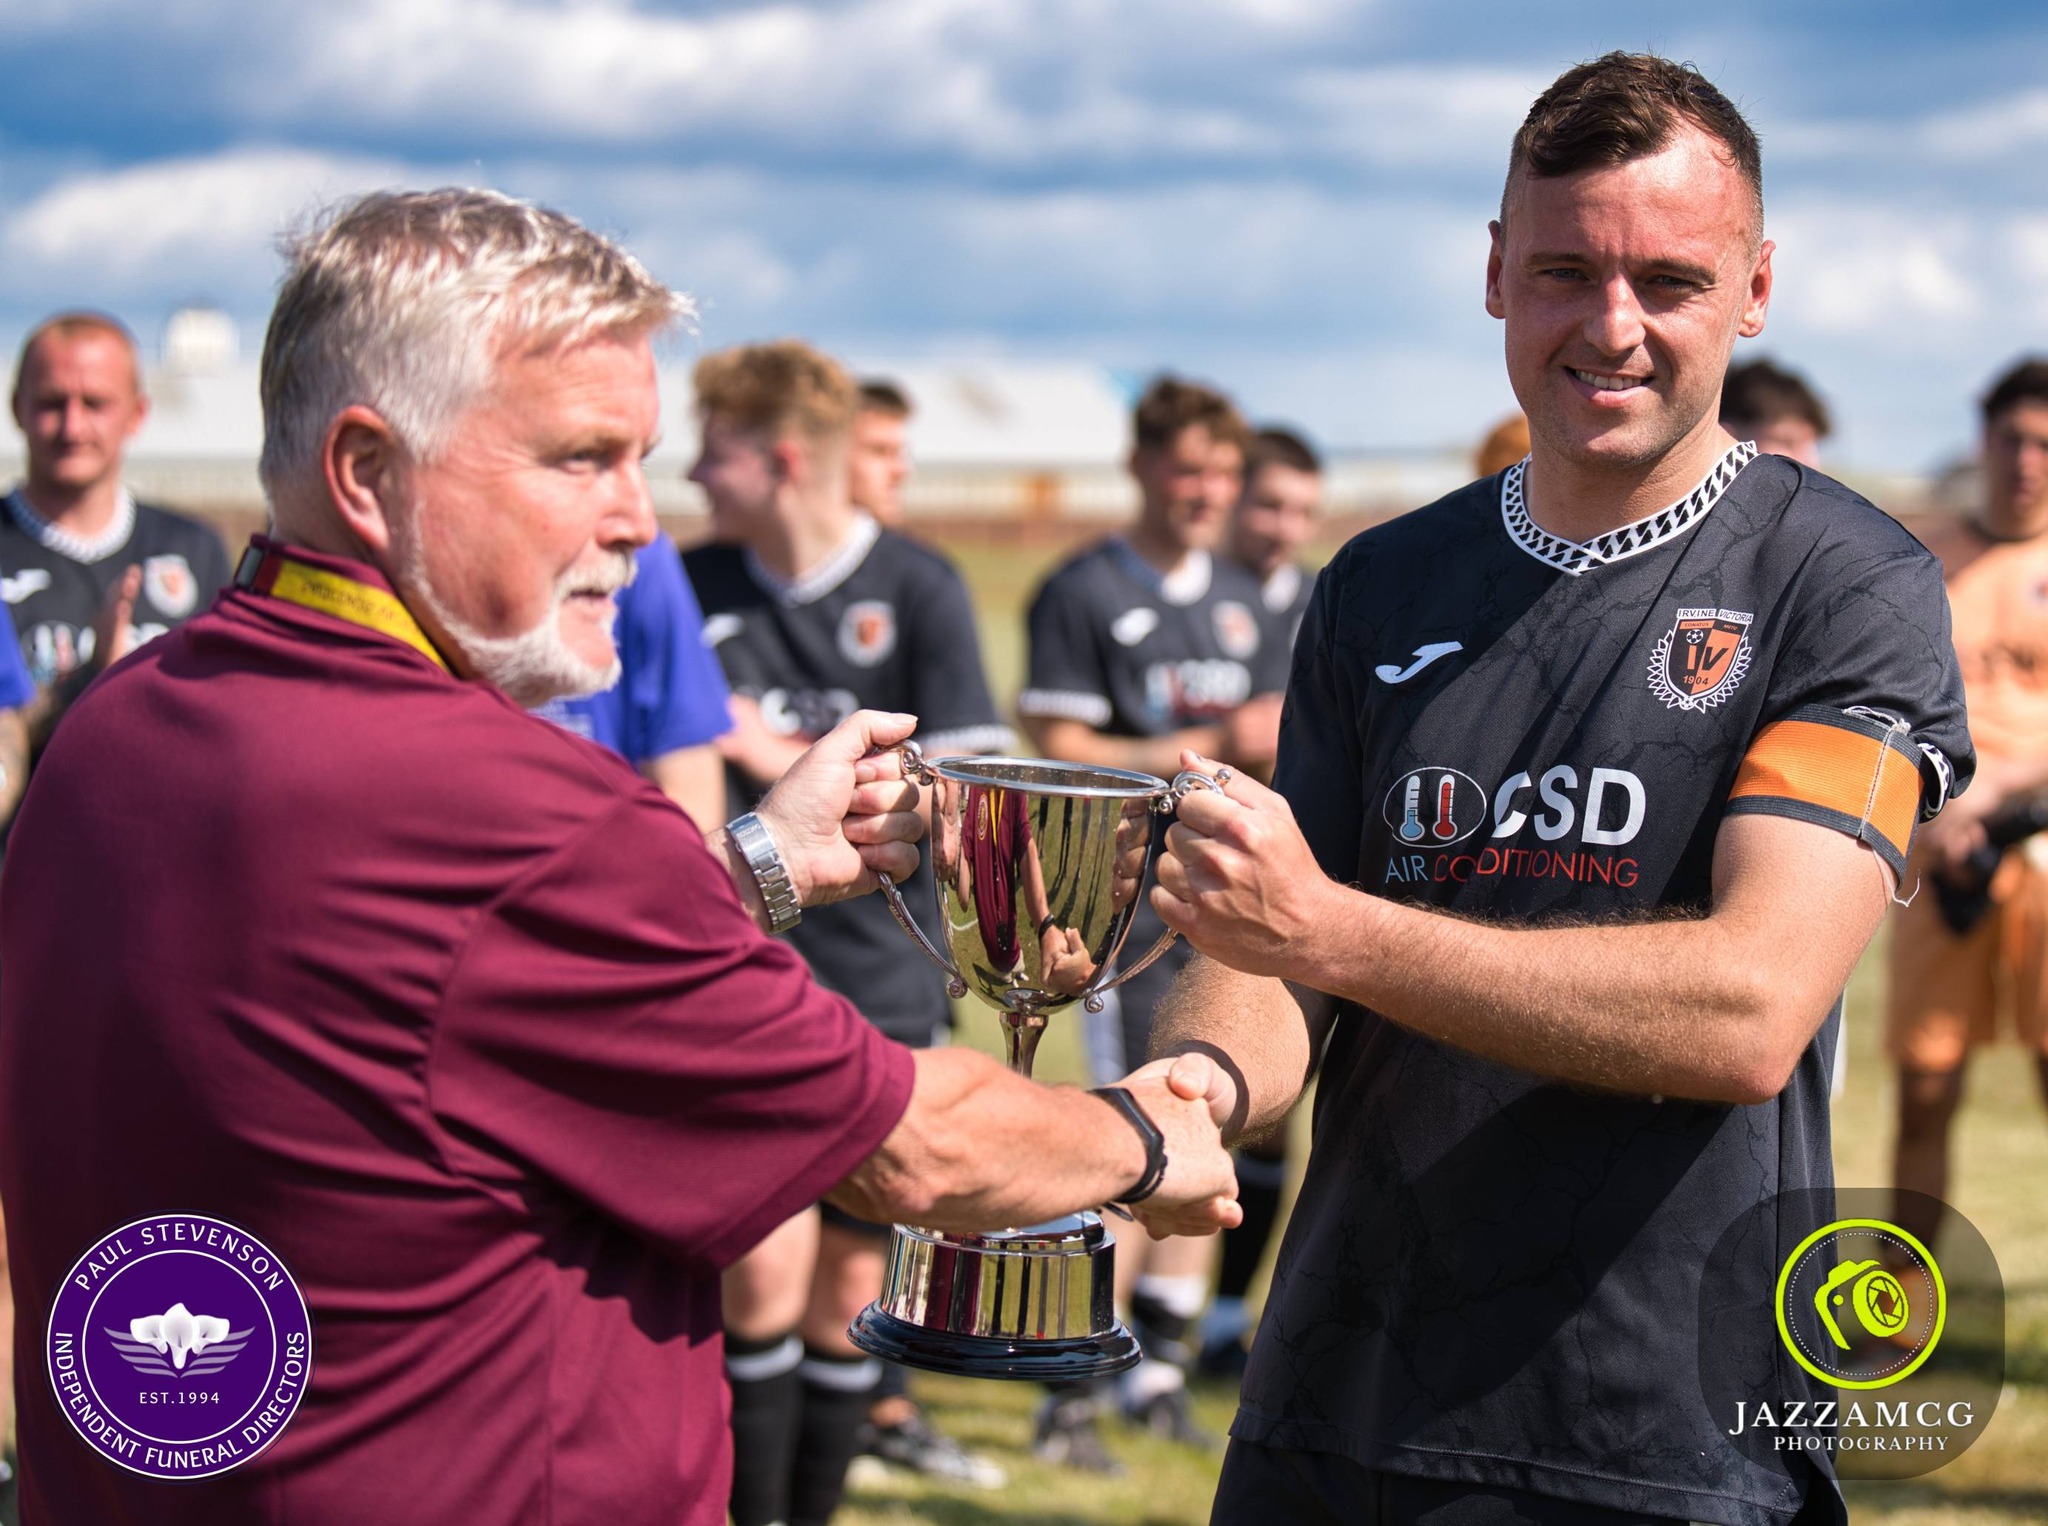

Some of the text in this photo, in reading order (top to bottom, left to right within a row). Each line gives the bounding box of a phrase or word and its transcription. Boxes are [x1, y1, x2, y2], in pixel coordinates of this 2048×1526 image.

[1678, 609, 1752, 622] IRVINE VICTORIA
[1683, 675, 1709, 686] 1904
[1491, 764, 1646, 846] CSD
[1385, 847, 1639, 888] AIR CODITIONING
